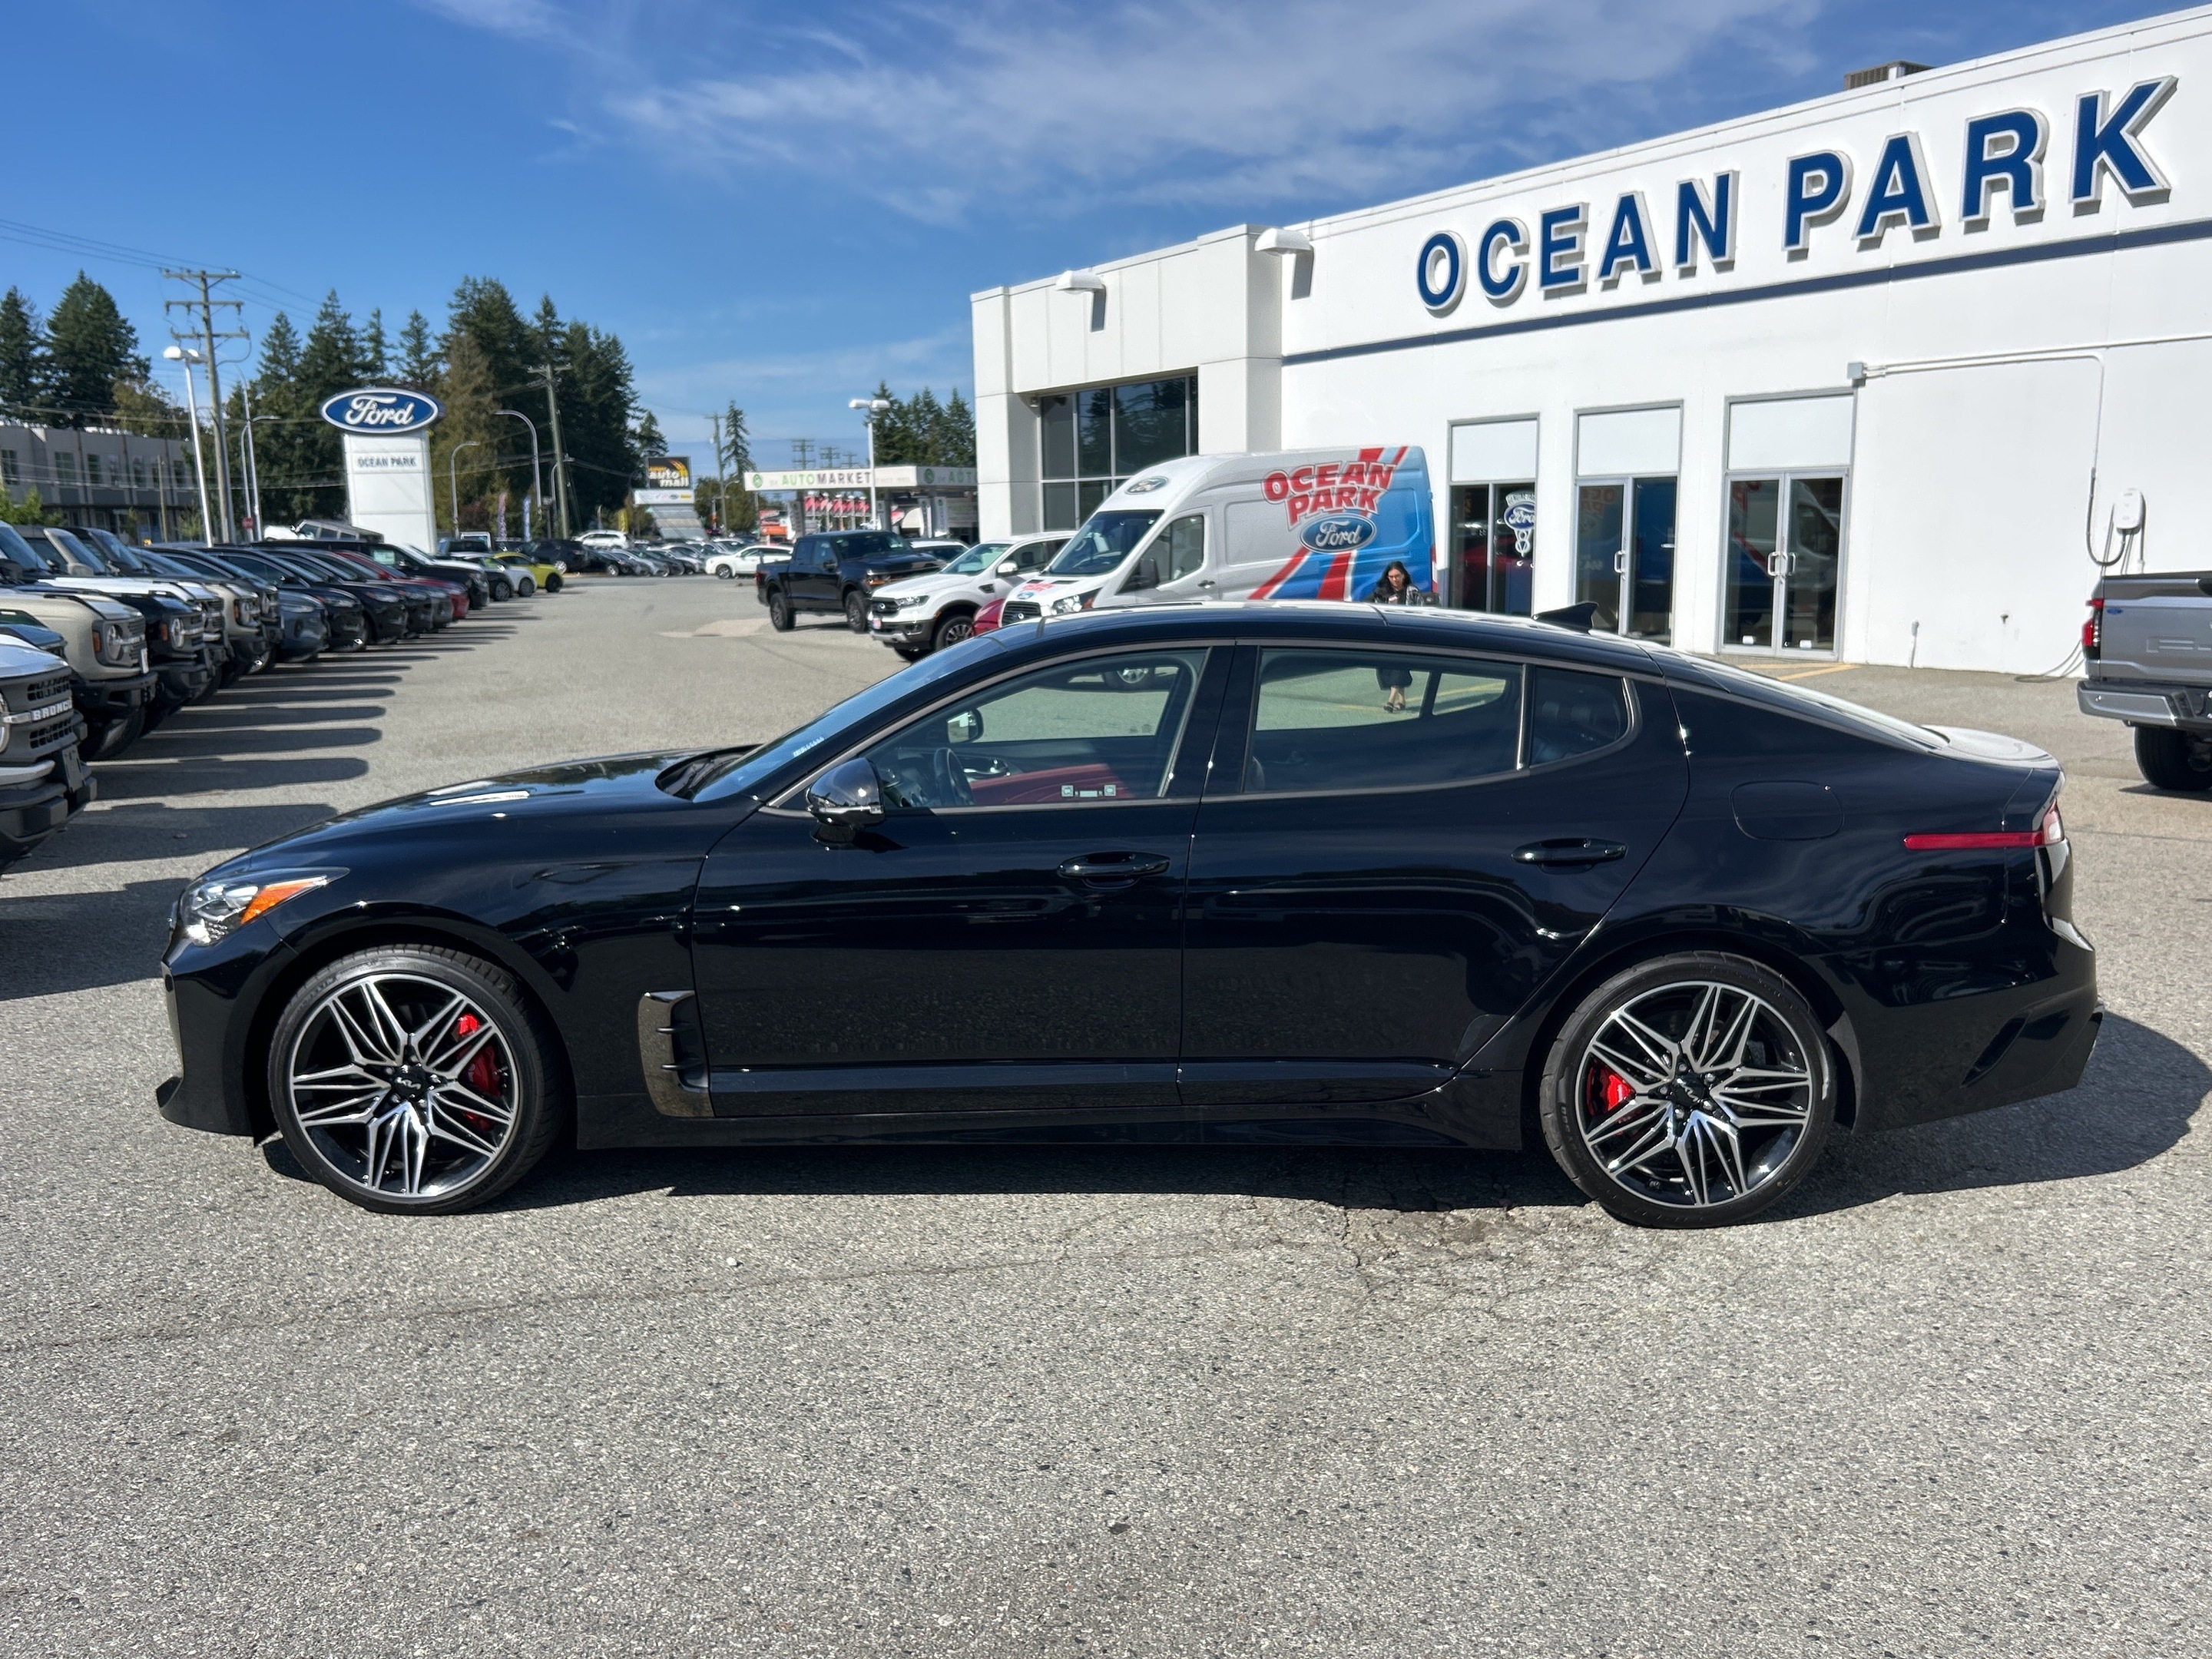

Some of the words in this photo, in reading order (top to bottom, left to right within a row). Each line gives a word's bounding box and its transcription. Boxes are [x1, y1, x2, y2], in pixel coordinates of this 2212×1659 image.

[1416, 170, 1737, 311] OCEAN
[1783, 75, 2177, 252] PARK
[346, 395, 415, 425] Ford
[358, 456, 388, 468] OCEAN
[390, 456, 416, 467] PARK
[649, 468, 680, 479] auto
[660, 476, 689, 487] mall
[1263, 462, 1397, 503] OCEAN
[1286, 486, 1382, 529] PARK
[1316, 520, 1362, 546] Ford
